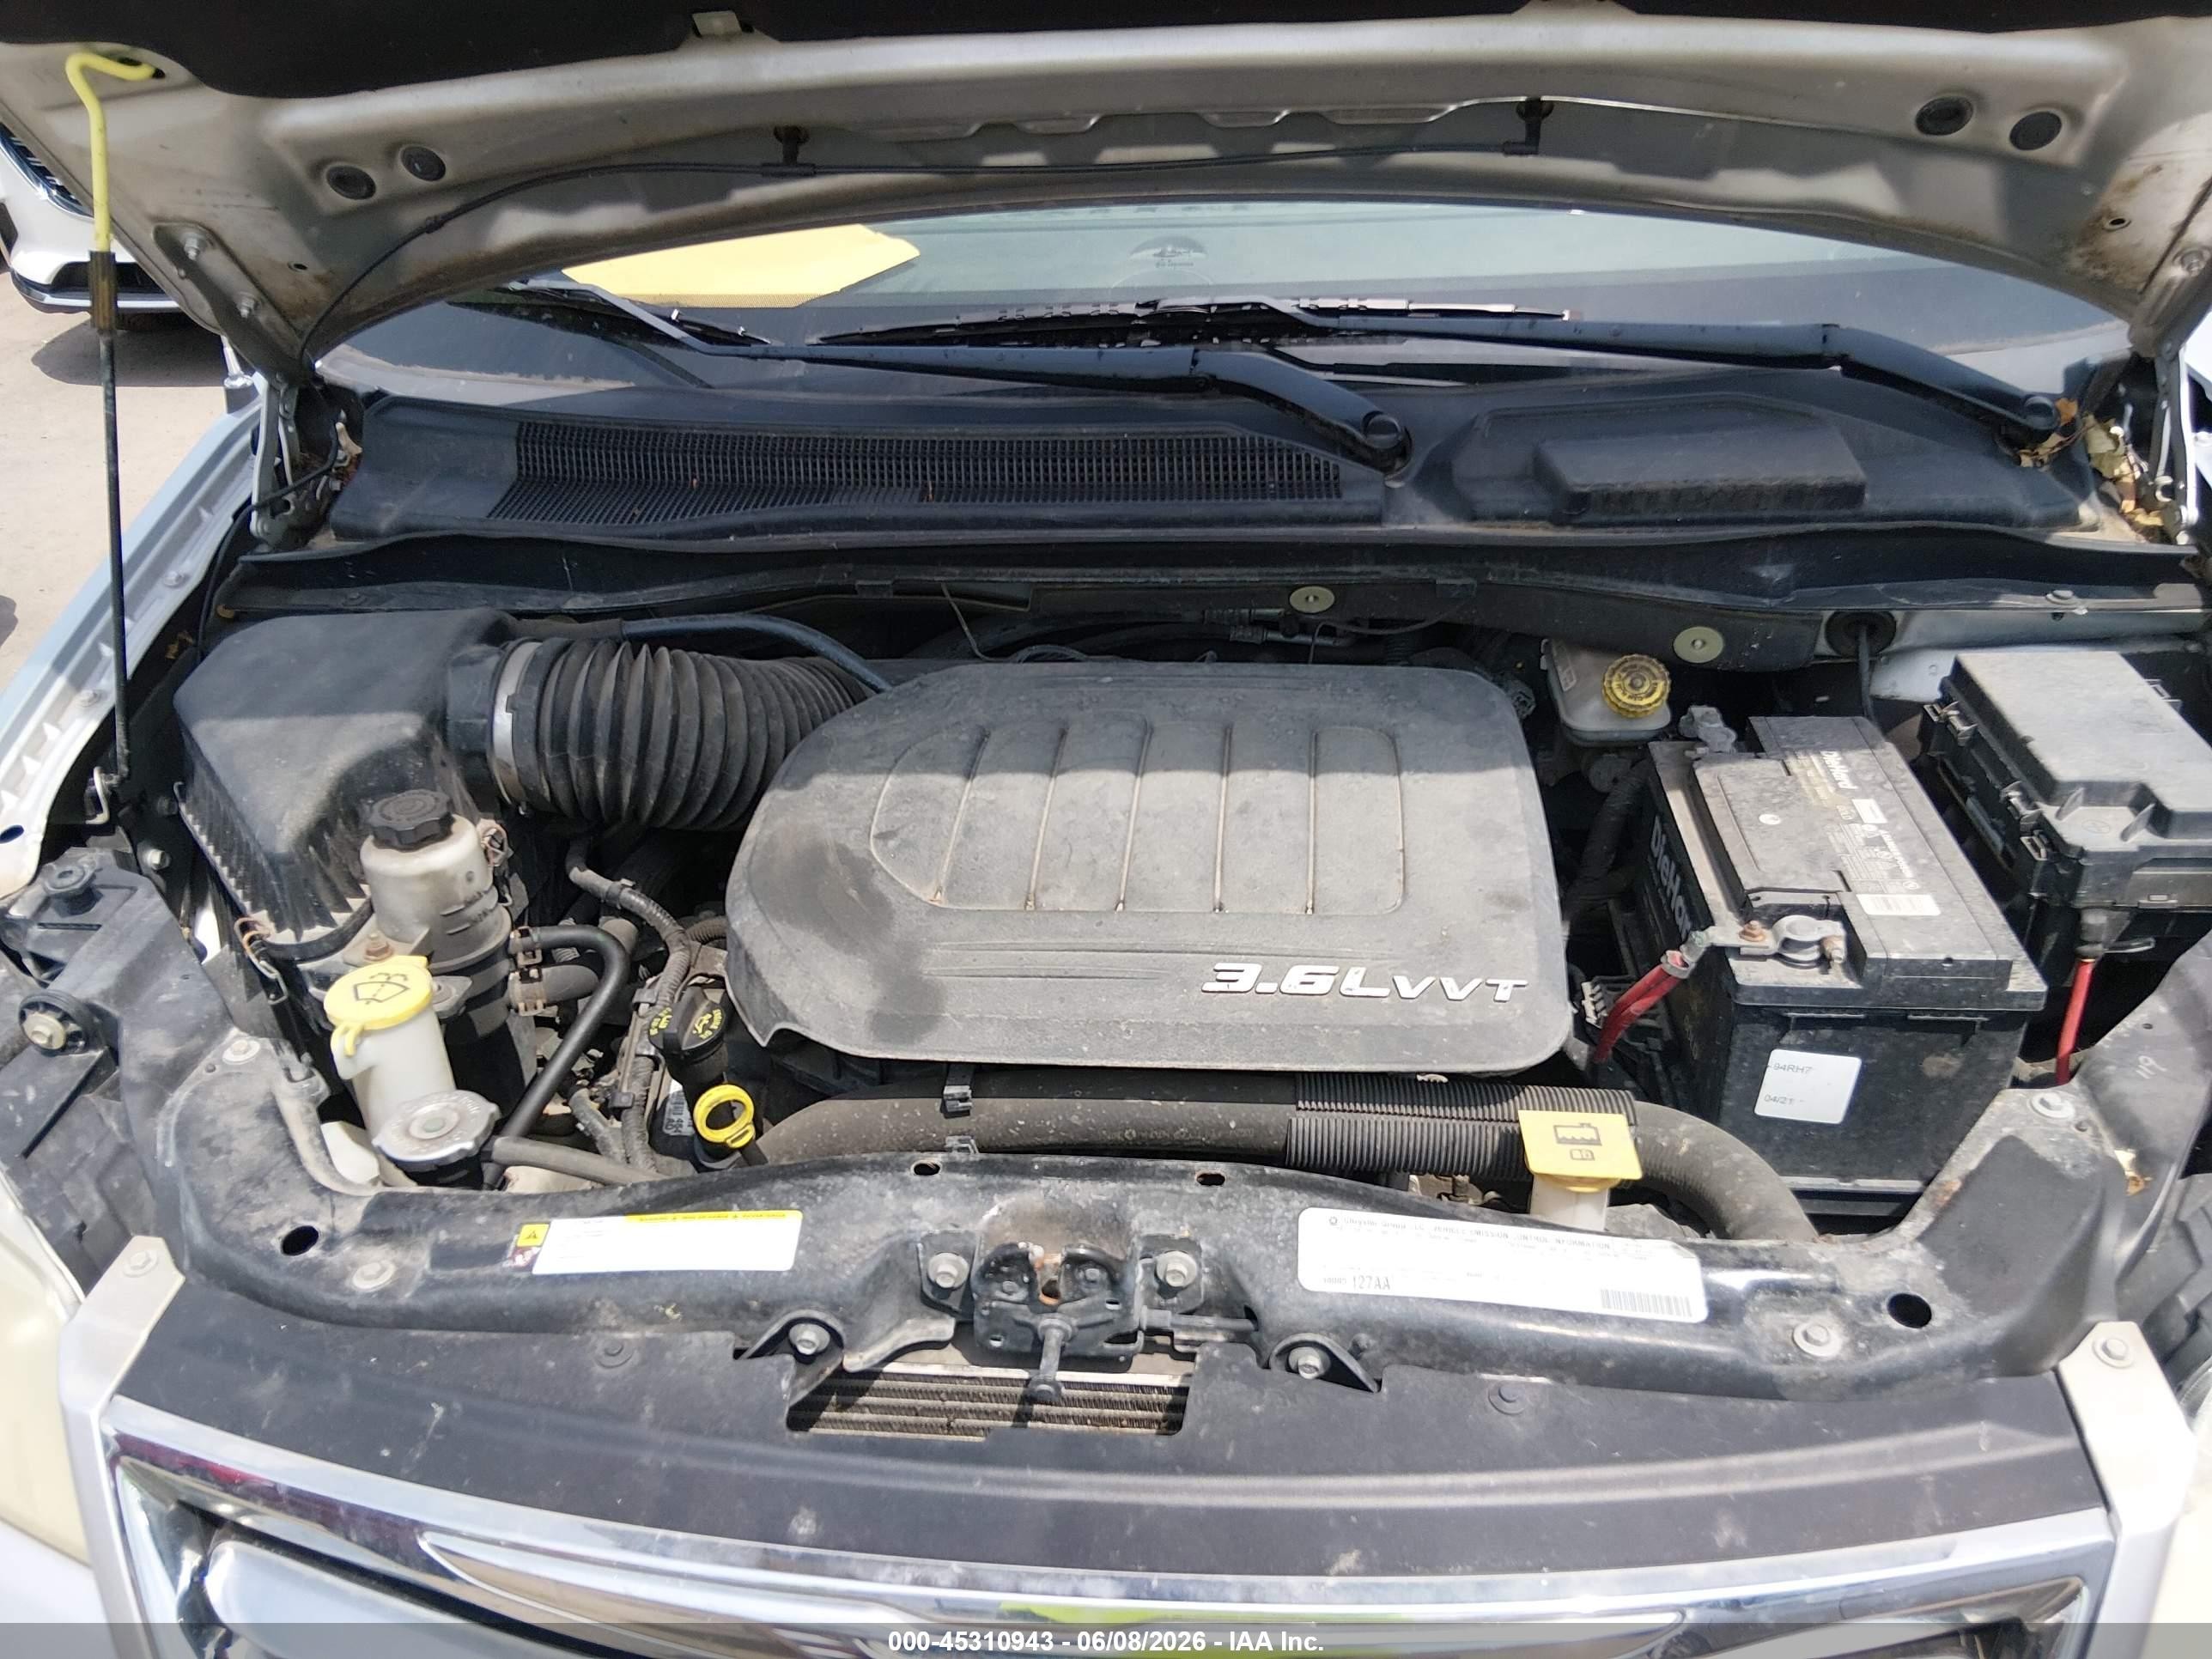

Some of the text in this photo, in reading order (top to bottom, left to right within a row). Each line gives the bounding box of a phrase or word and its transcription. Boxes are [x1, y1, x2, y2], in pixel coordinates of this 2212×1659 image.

[1820, 750, 1859, 790] DieHard
[1650, 815, 1692, 942] DieHar
[1200, 962, 1529, 1003] 3.6L VVT
